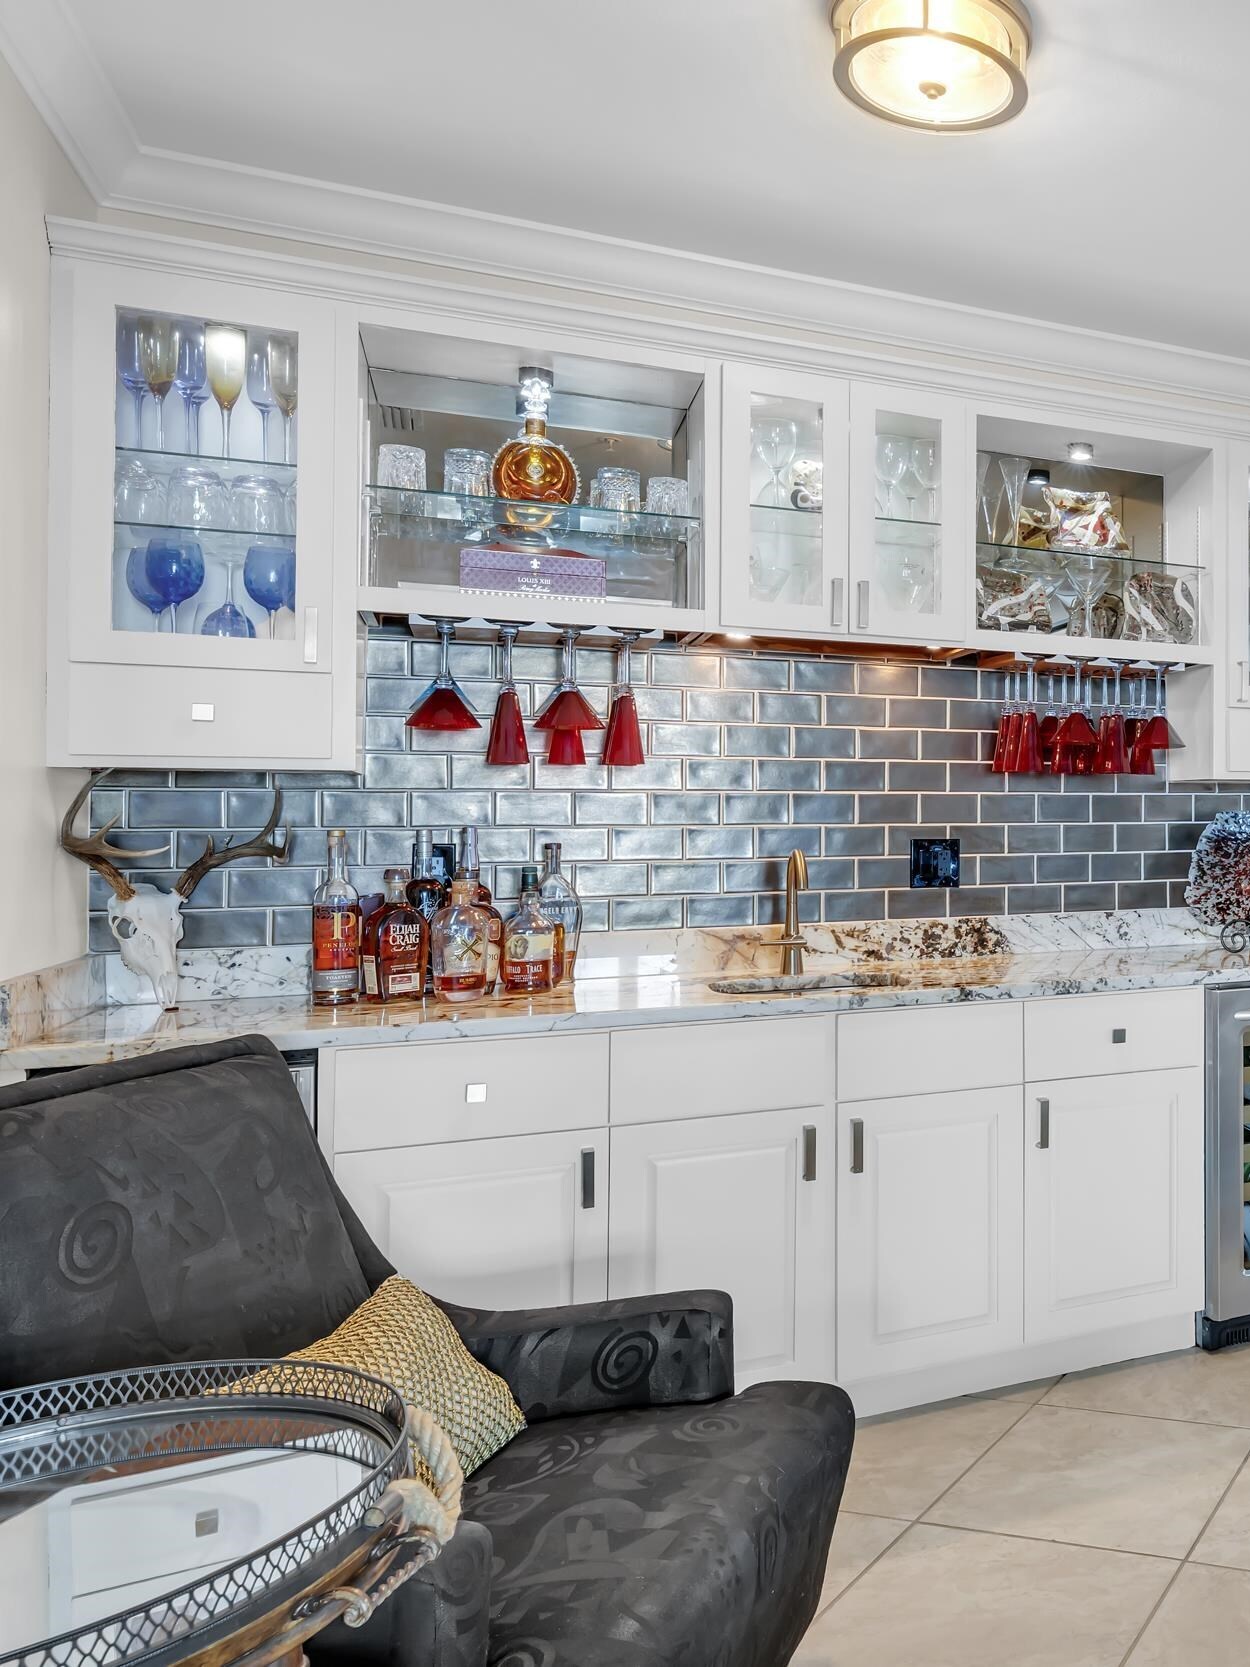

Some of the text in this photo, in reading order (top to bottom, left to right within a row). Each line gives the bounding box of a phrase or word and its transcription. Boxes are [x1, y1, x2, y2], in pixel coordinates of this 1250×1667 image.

[330, 912, 356, 940] P
[389, 923, 420, 935] ELIJAH
[389, 933, 420, 945] CRAIG
[526, 964, 543, 974] TRACE
